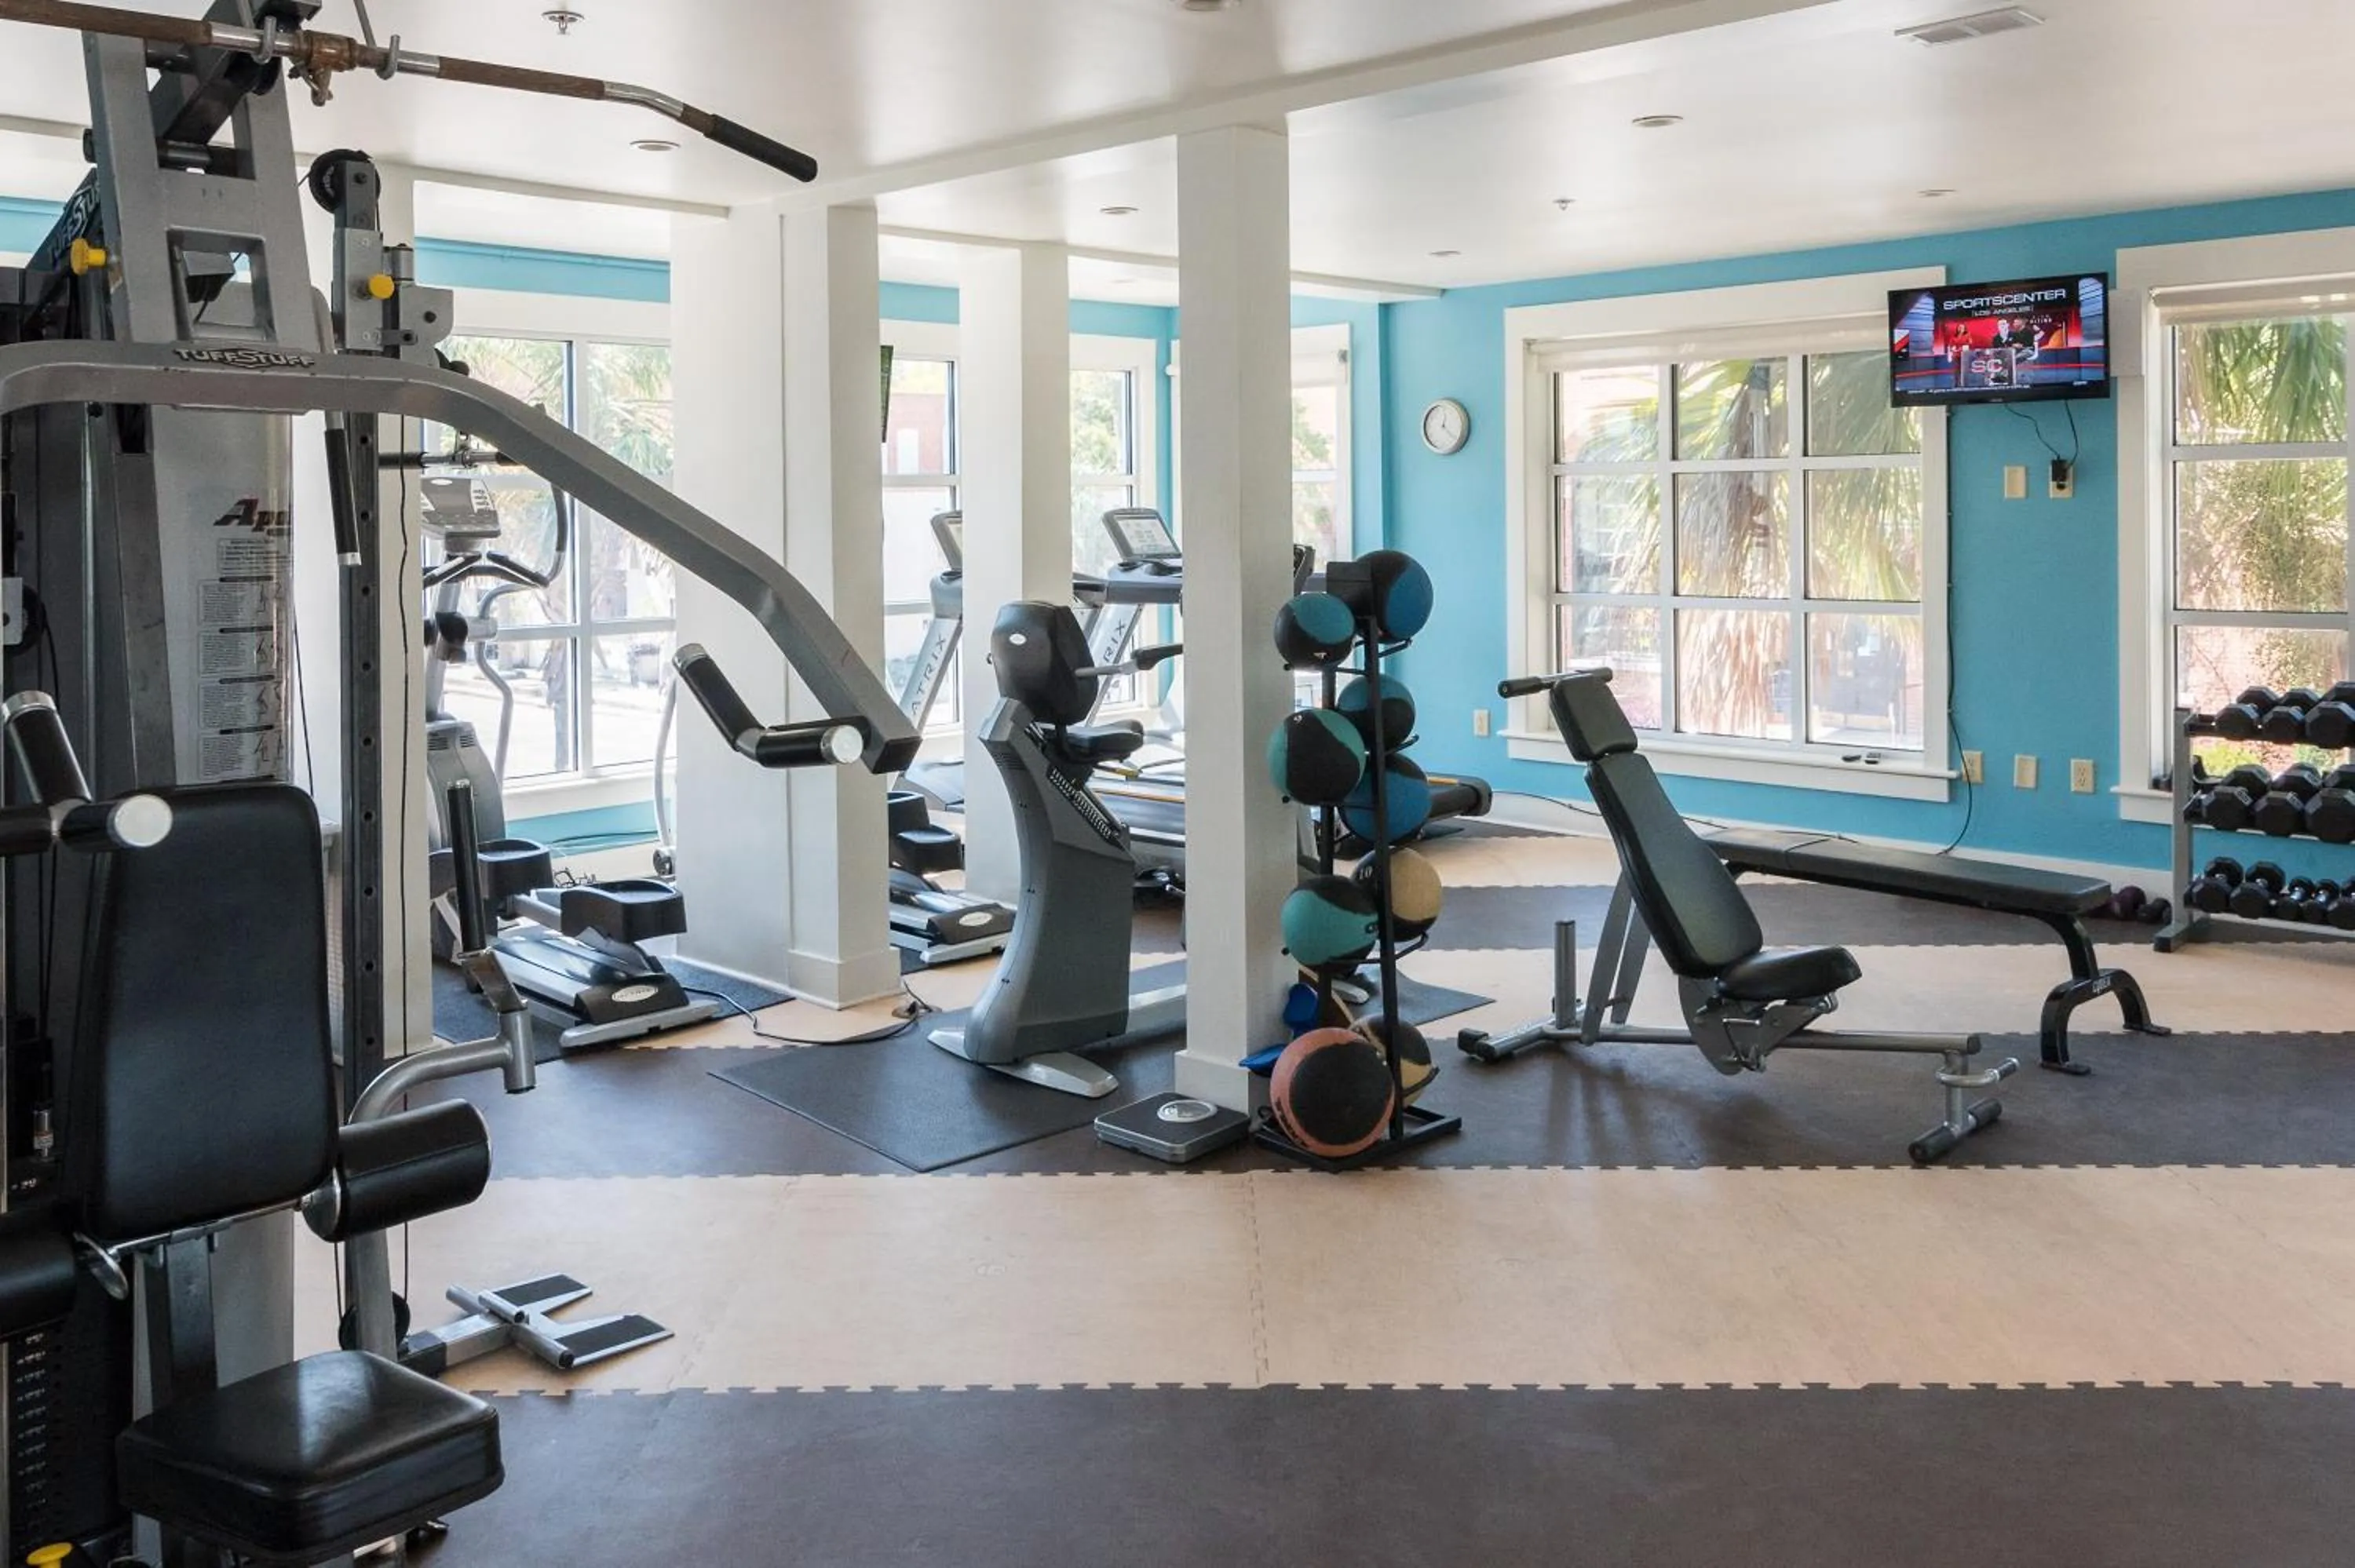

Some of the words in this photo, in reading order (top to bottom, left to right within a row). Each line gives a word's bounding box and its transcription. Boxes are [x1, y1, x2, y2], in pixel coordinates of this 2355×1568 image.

[1943, 288, 2066, 311] SPORTSCENTER
[173, 348, 316, 368] TUFFSTUFF
[1971, 358, 2003, 374] SC
[1102, 617, 1126, 663] RIX
[911, 633, 946, 716] ATRIX
